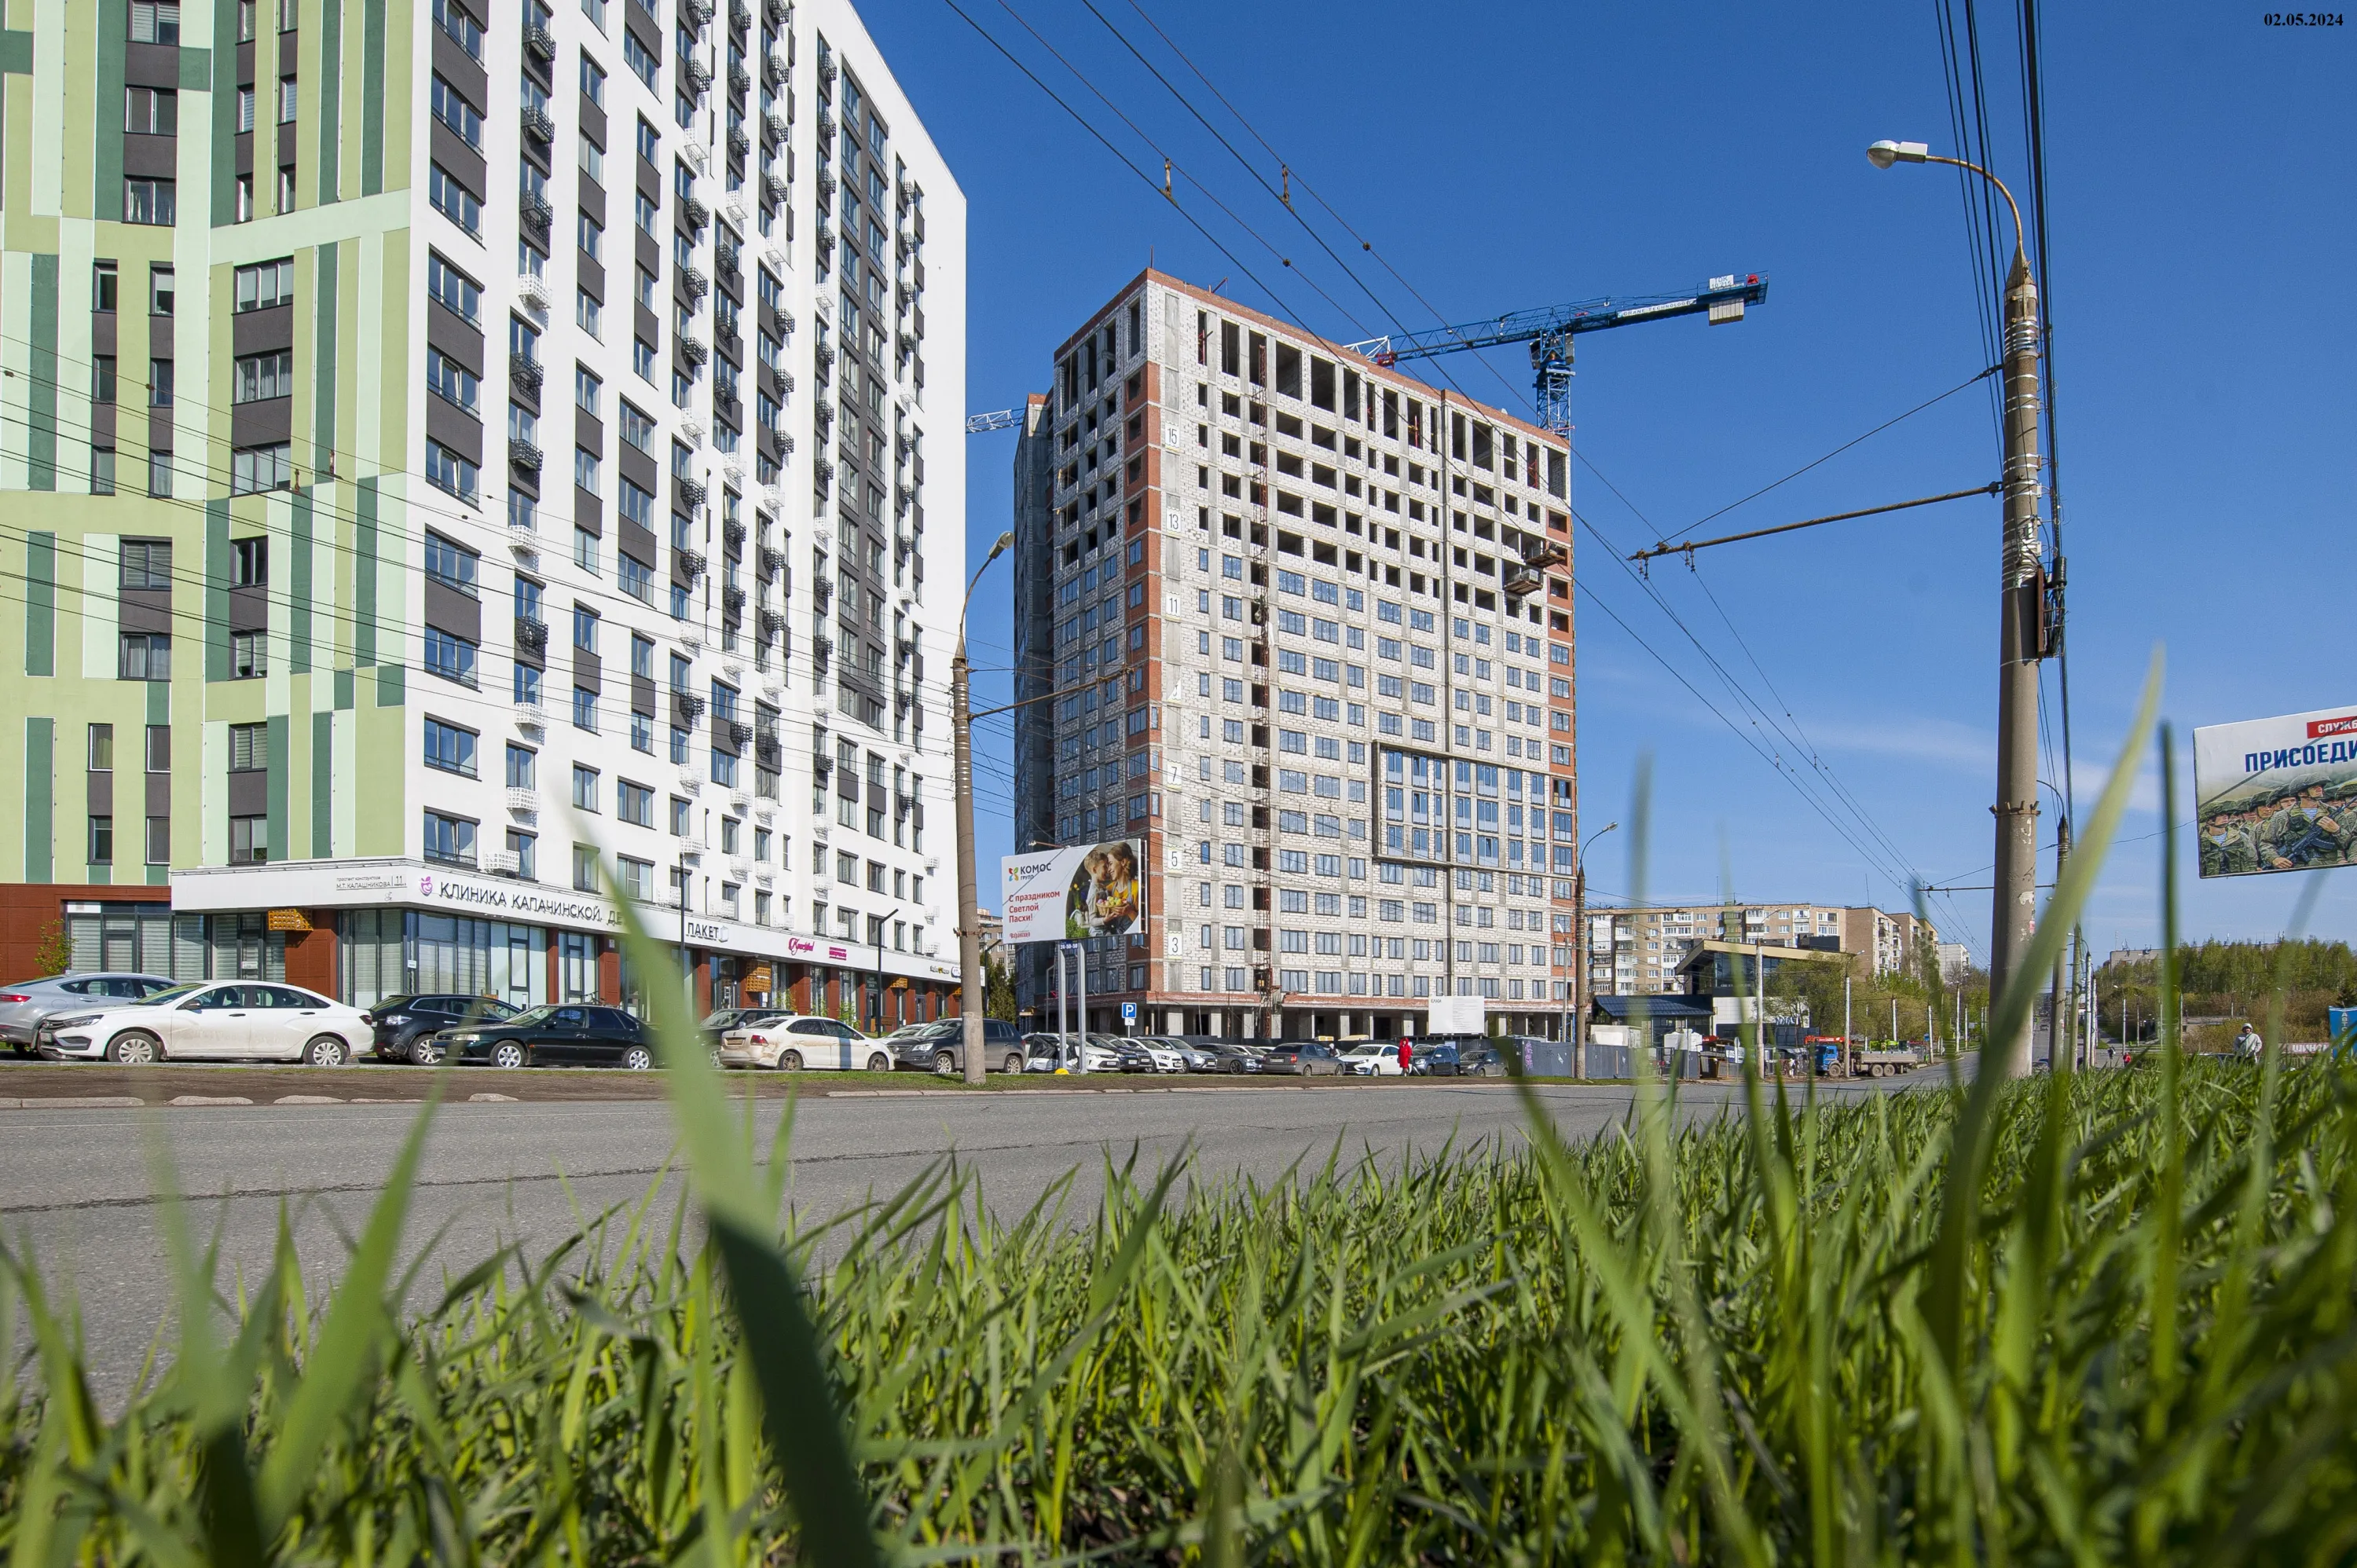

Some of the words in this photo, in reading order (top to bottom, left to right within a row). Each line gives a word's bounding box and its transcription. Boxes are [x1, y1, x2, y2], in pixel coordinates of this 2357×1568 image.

[1168, 428, 1178, 445] 15
[1170, 514, 1178, 529] 13
[1170, 598, 1178, 614] 11
[1171, 766, 1178, 782] 7
[1171, 851, 1178, 867] 5
[1020, 863, 1051, 875] КОМОС
[396, 875, 402, 884] 11
[440, 881, 507, 906] КЛИНИКА
[607, 910, 623, 925] ДЕ
[1015, 891, 1060, 903] праздником
[1009, 903, 1039, 913] Светлой
[1009, 914, 1033, 923] Пасхи!
[687, 922, 719, 939] ПАКЕТ
[1172, 937, 1179, 953] 3
[1126, 1005, 1134, 1017] P
